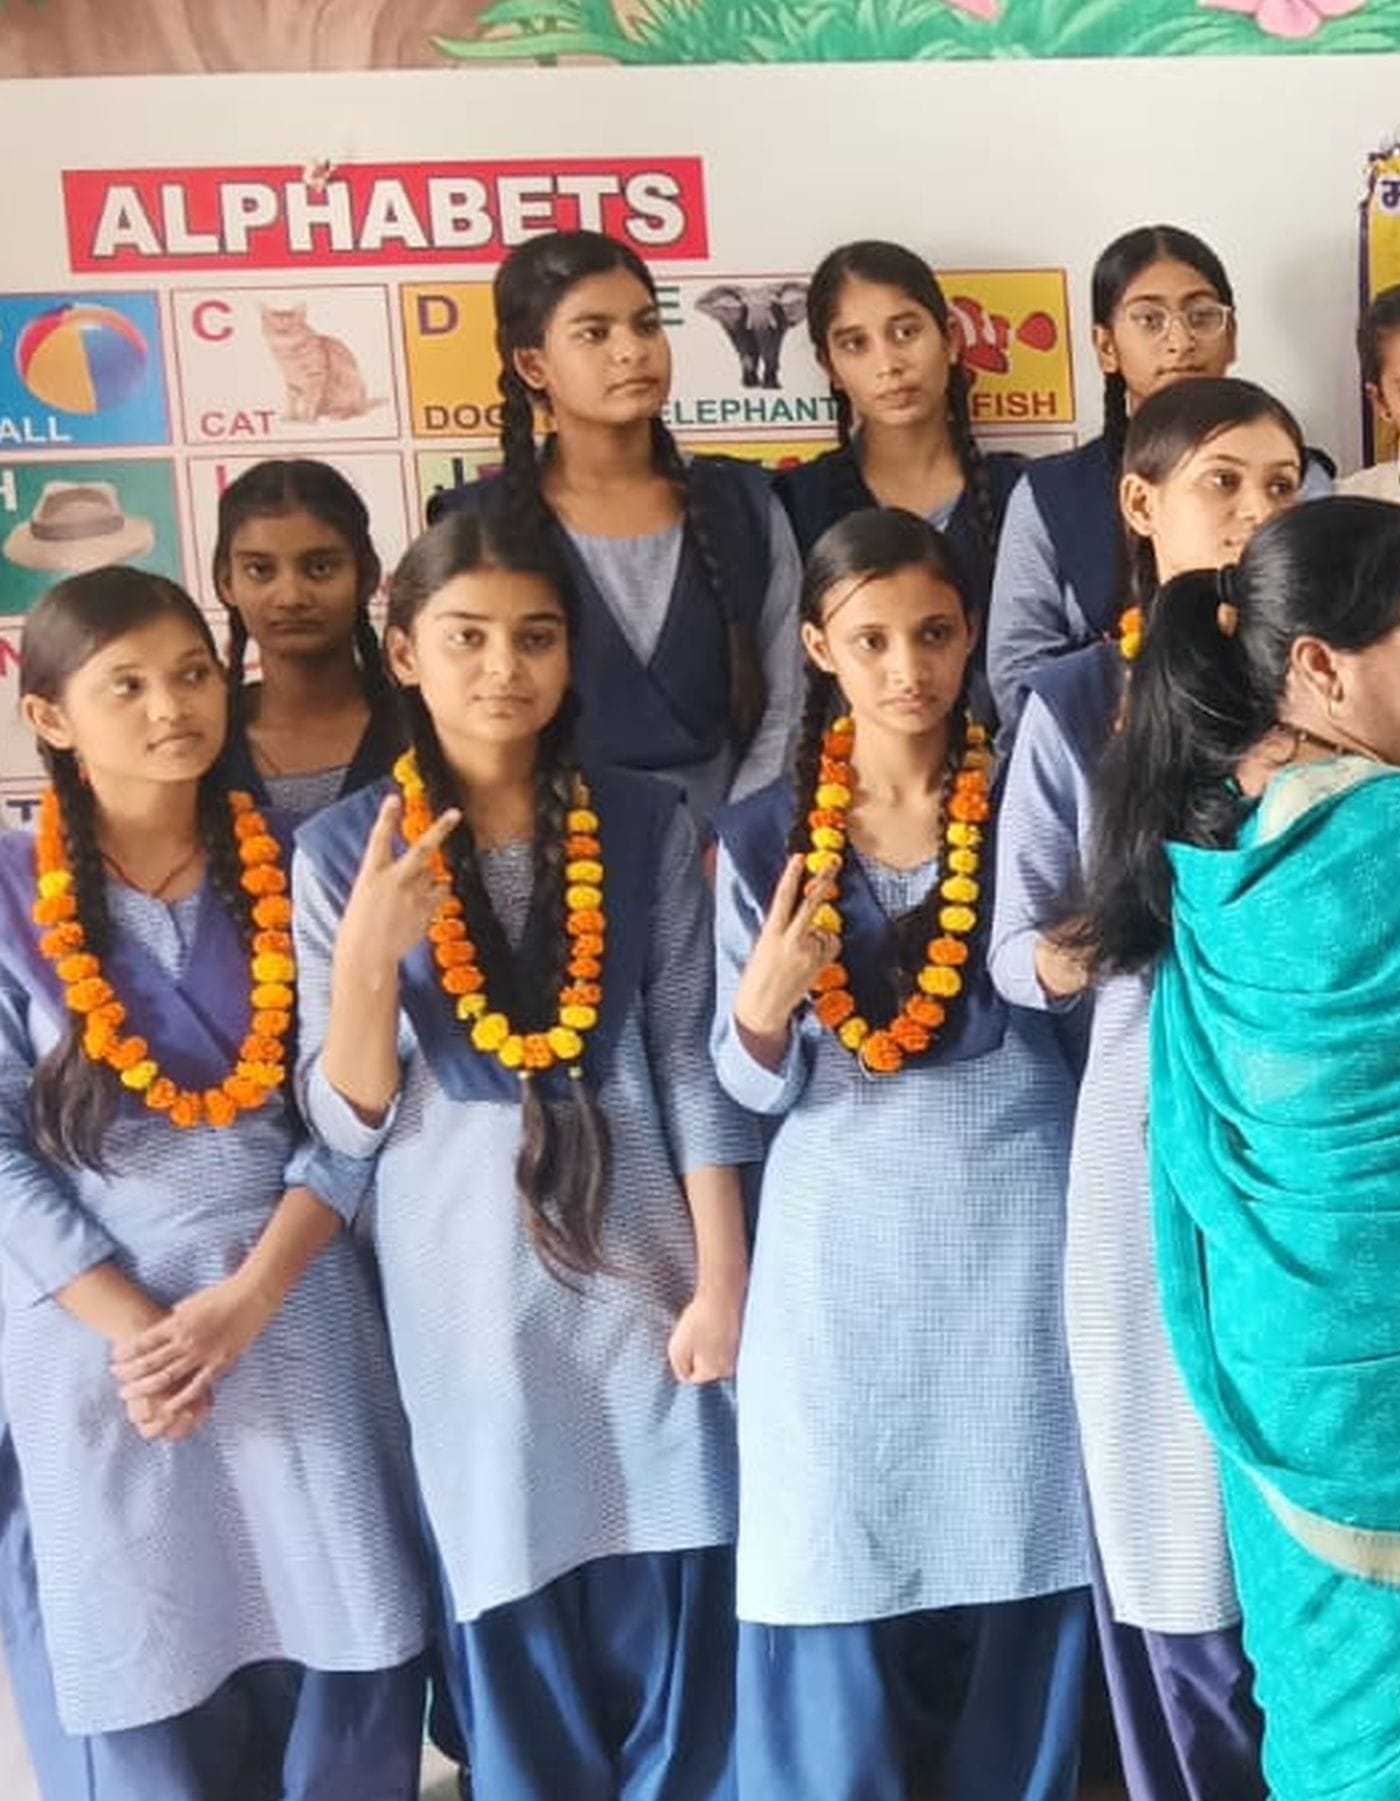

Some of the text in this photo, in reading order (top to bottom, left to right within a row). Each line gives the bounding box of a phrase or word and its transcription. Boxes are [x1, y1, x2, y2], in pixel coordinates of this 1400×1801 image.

[91, 172, 689, 258] ALPHABETS
[191, 299, 235, 342] C
[417, 294, 459, 336] D
[972, 390, 1057, 419] FISH
[0, 416, 72, 443] ALL
[200, 410, 275, 438] CAT
